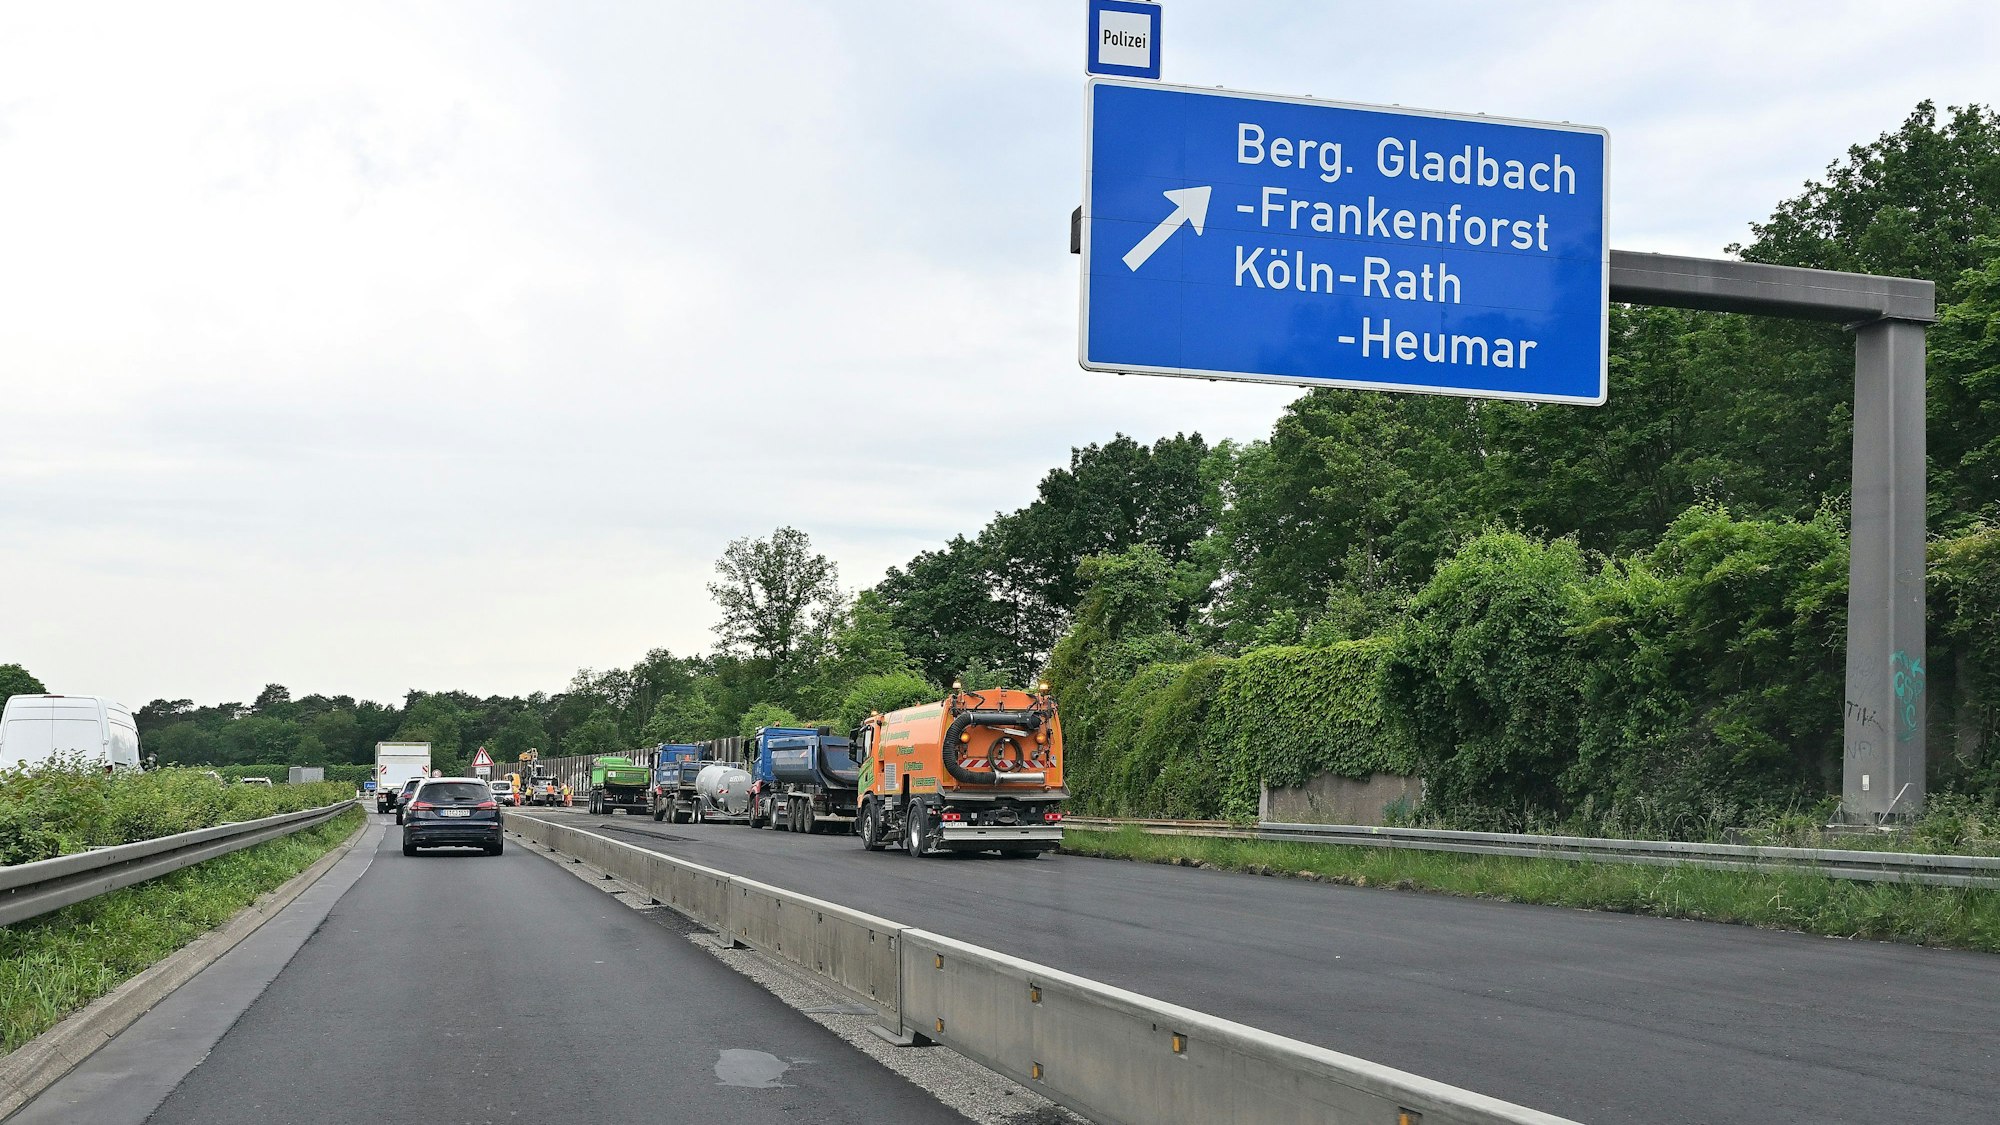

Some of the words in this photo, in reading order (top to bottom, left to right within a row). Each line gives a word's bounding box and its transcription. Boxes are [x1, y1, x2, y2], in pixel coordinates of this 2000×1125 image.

[1103, 29, 1146, 49] Polizei
[1237, 122, 1354, 183] Berg.
[1377, 137, 1577, 195] Gladbach
[1236, 185, 1550, 252] -Frankenforst
[1235, 245, 1462, 305] Köln-Rath
[1338, 317, 1539, 370] -Heumar
